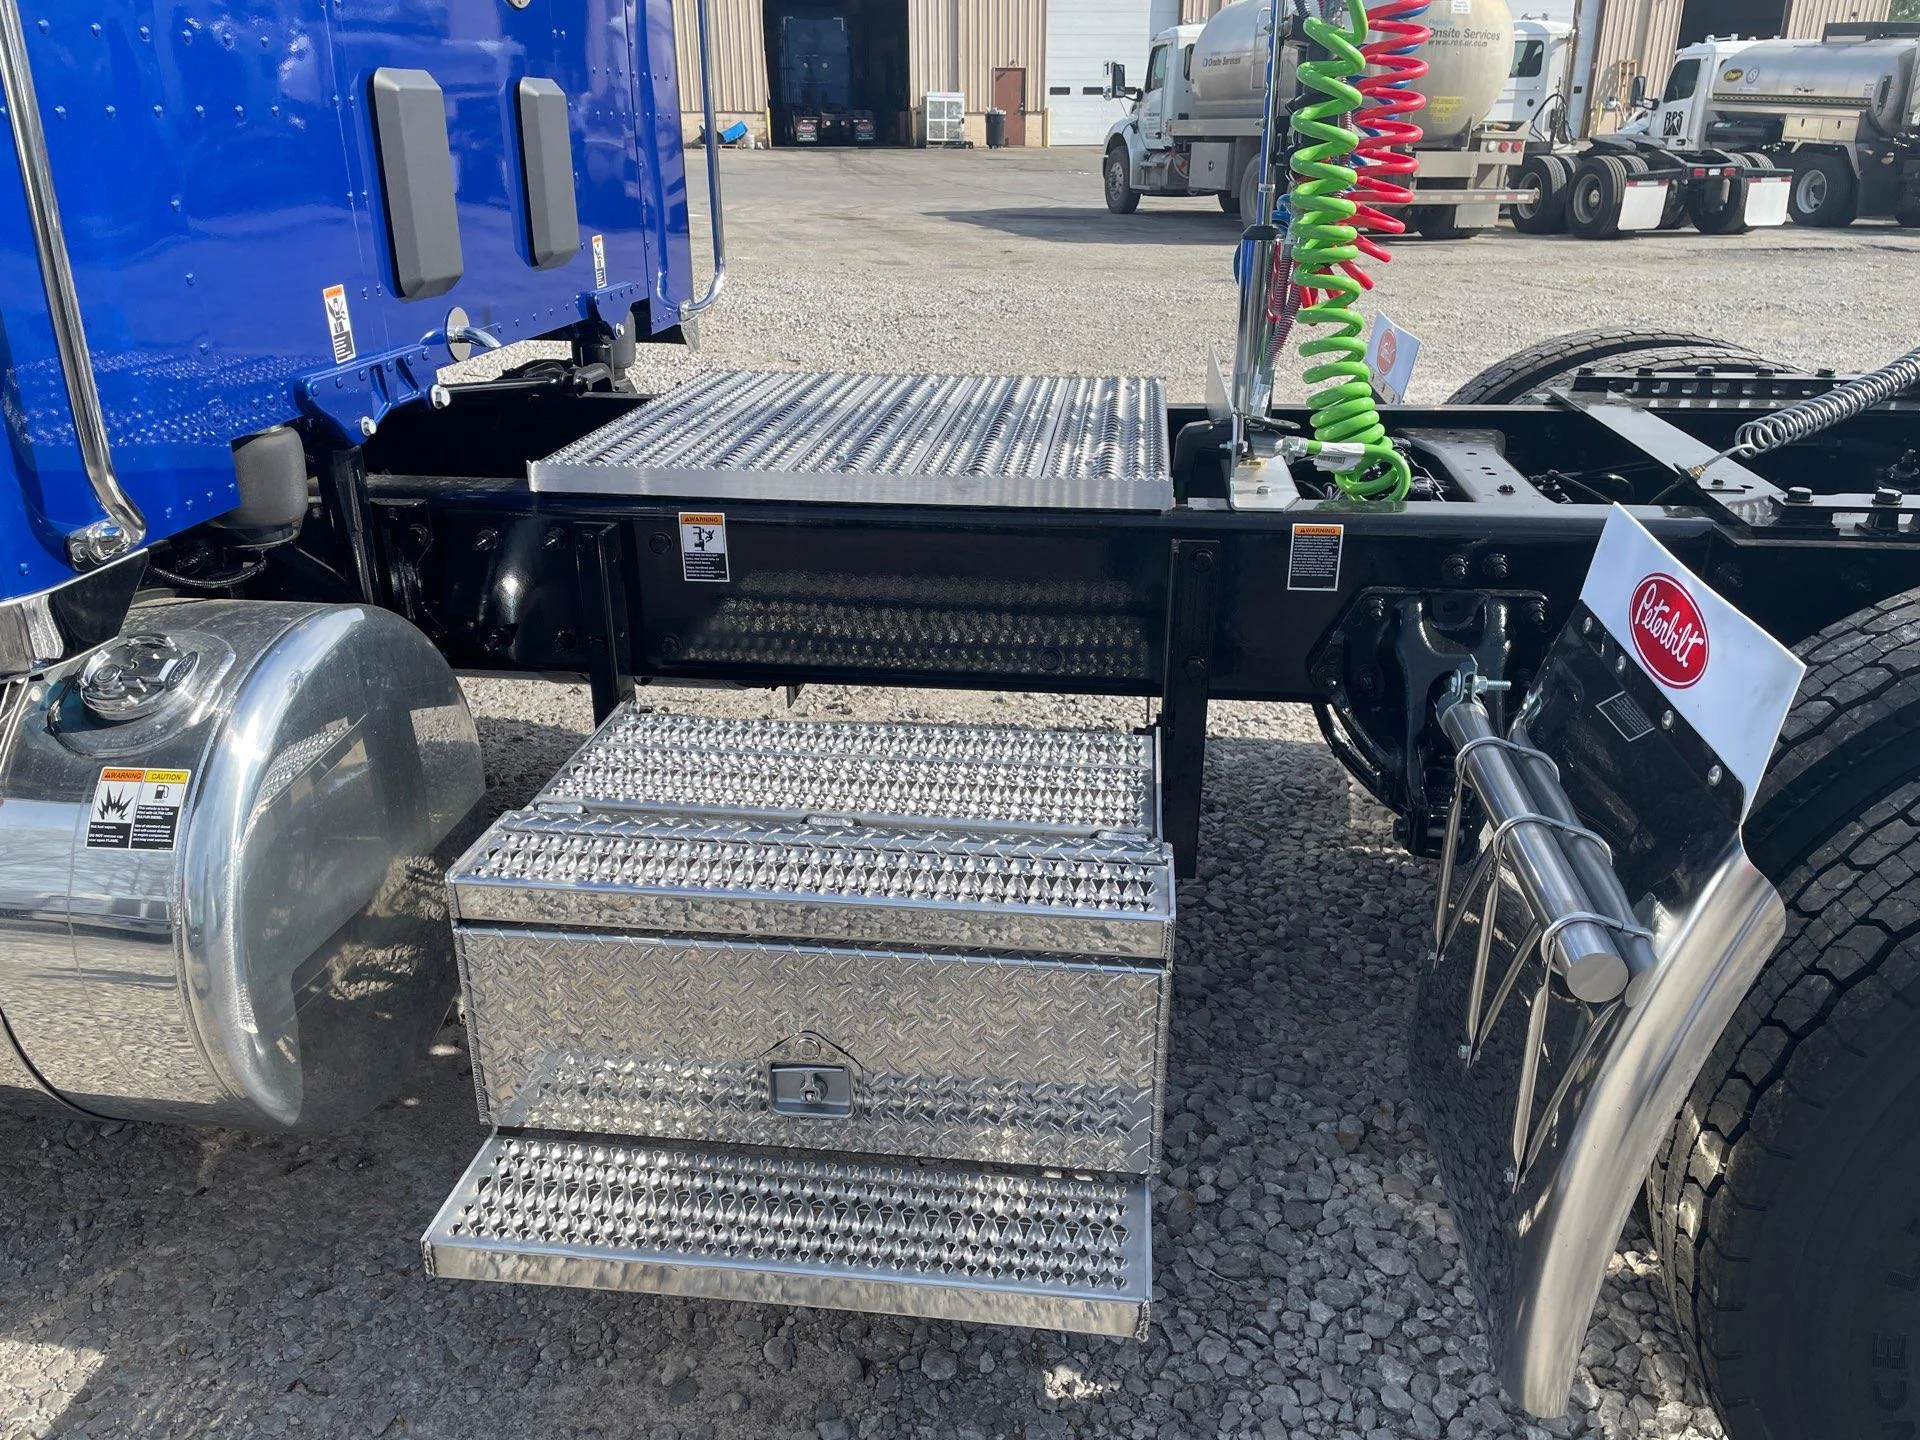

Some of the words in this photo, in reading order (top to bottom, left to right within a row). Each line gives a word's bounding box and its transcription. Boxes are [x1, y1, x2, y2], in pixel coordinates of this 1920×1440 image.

[1463, 27, 1501, 40] Services
[1635, 583, 1704, 668] Peterbilt
[110, 771, 142, 779] WARNING
